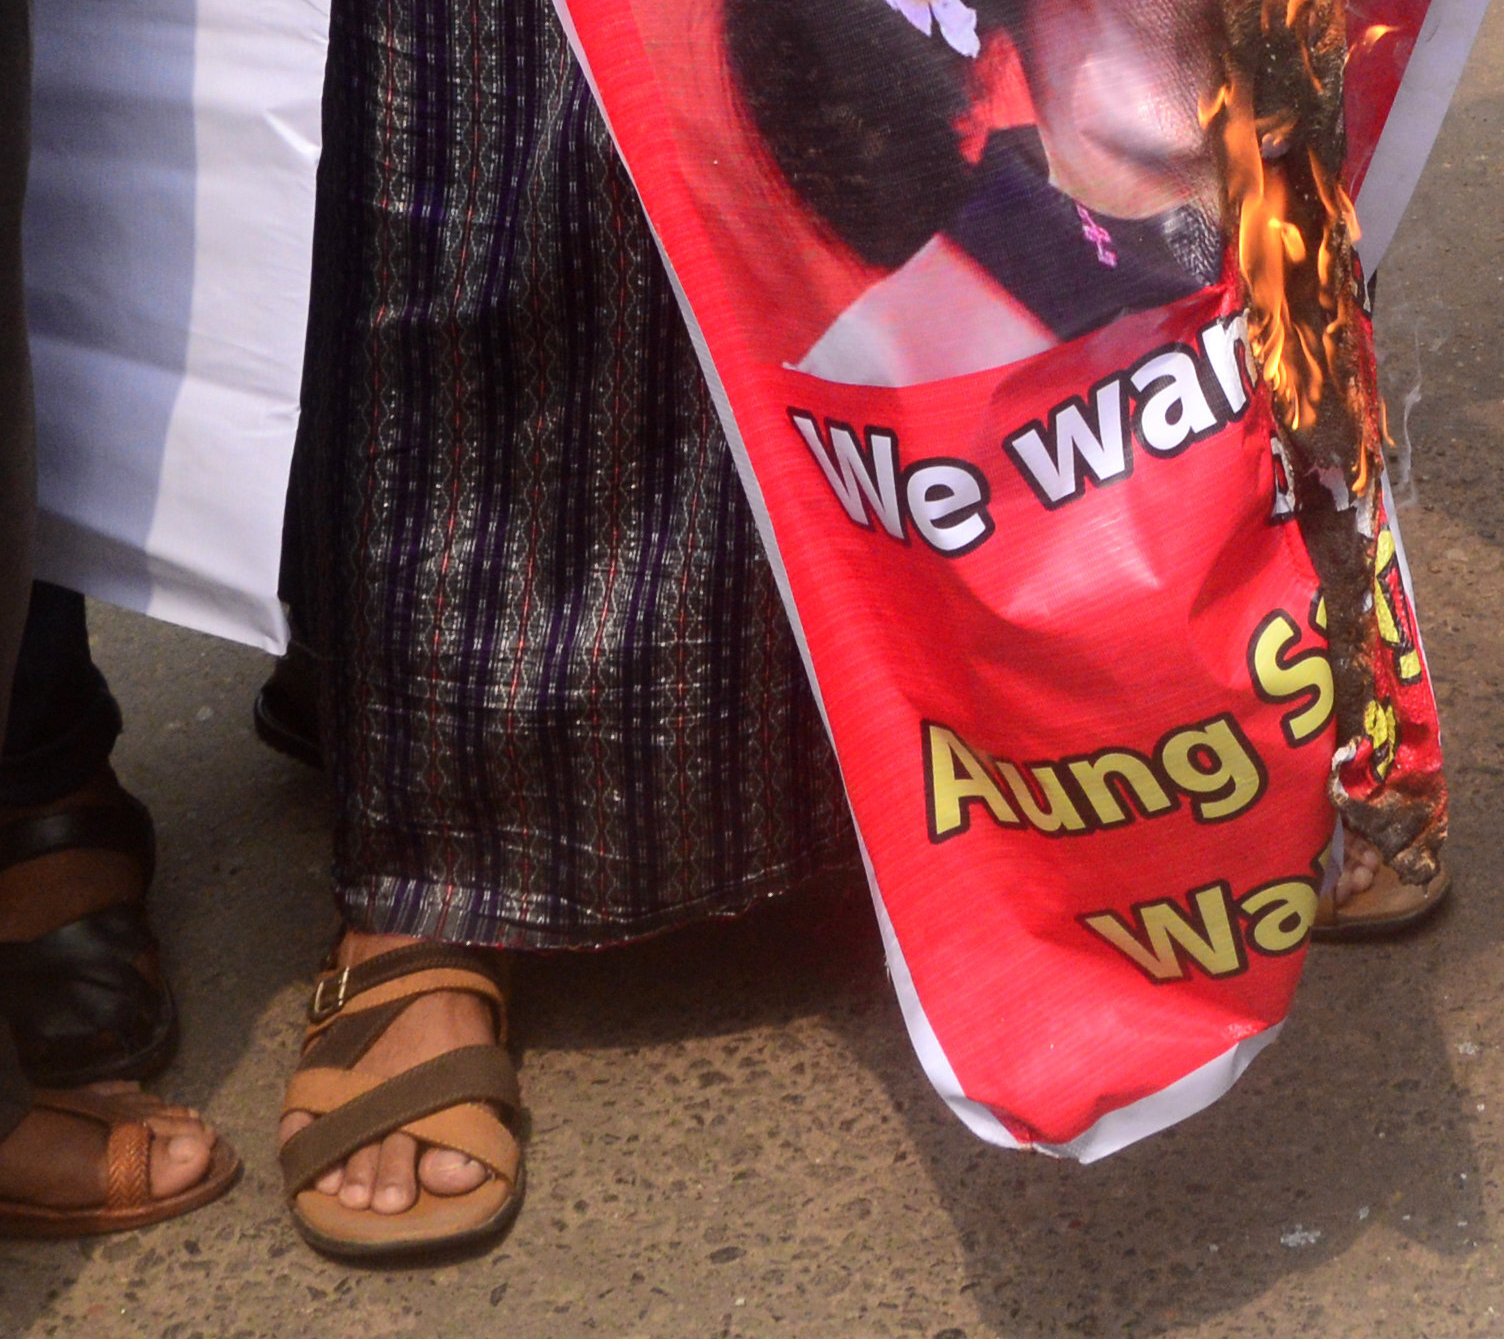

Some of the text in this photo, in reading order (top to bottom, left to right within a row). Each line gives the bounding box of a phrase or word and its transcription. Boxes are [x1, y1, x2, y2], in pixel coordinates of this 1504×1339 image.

[787, 407, 994, 556] We
[921, 712, 1268, 843] Aung
[1076, 853, 1334, 983] Wa
